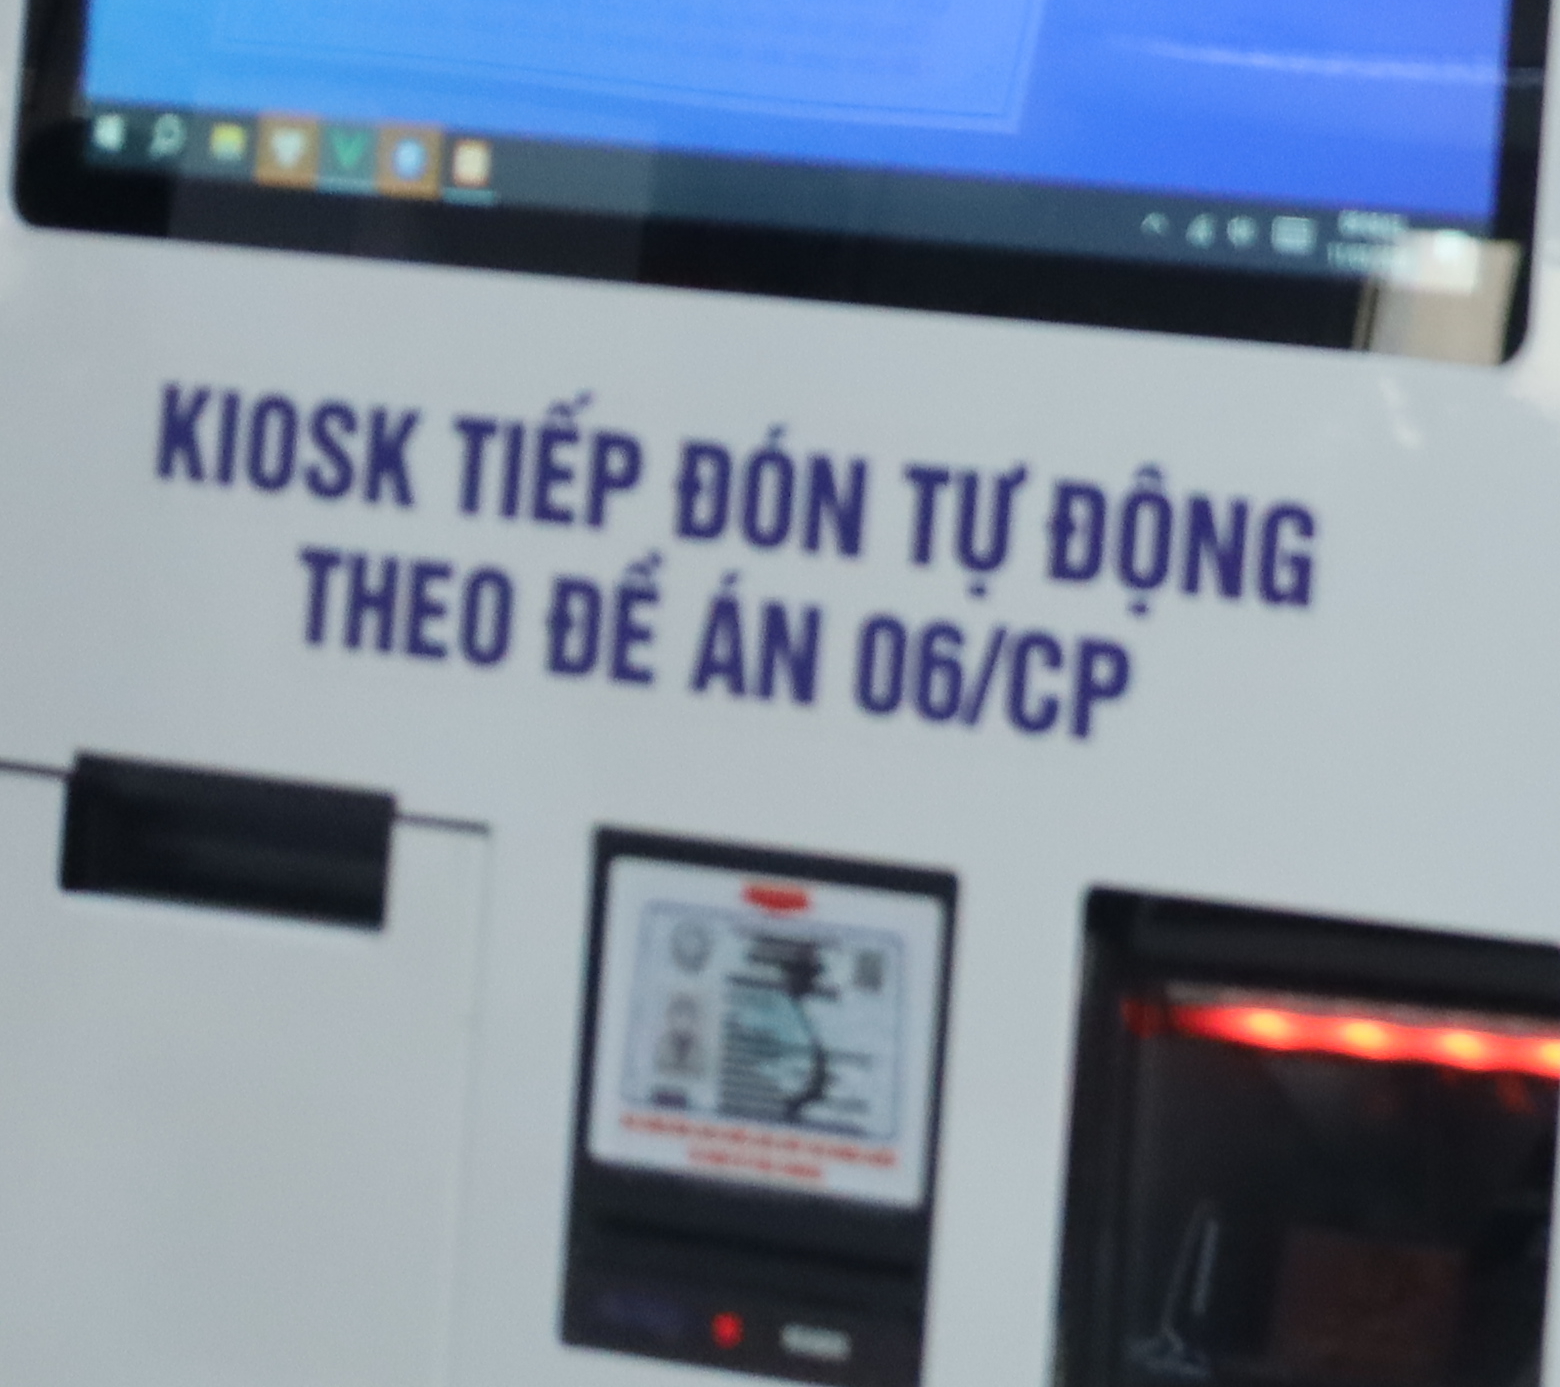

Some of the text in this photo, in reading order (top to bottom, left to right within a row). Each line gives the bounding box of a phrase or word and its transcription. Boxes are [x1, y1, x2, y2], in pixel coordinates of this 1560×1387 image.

[154, 382, 1318, 618] KIOSK TIẾP ĐÓN TỰ ĐỘNG
[297, 542, 1134, 740] THEO ĐỀ ÁN 06/CP
